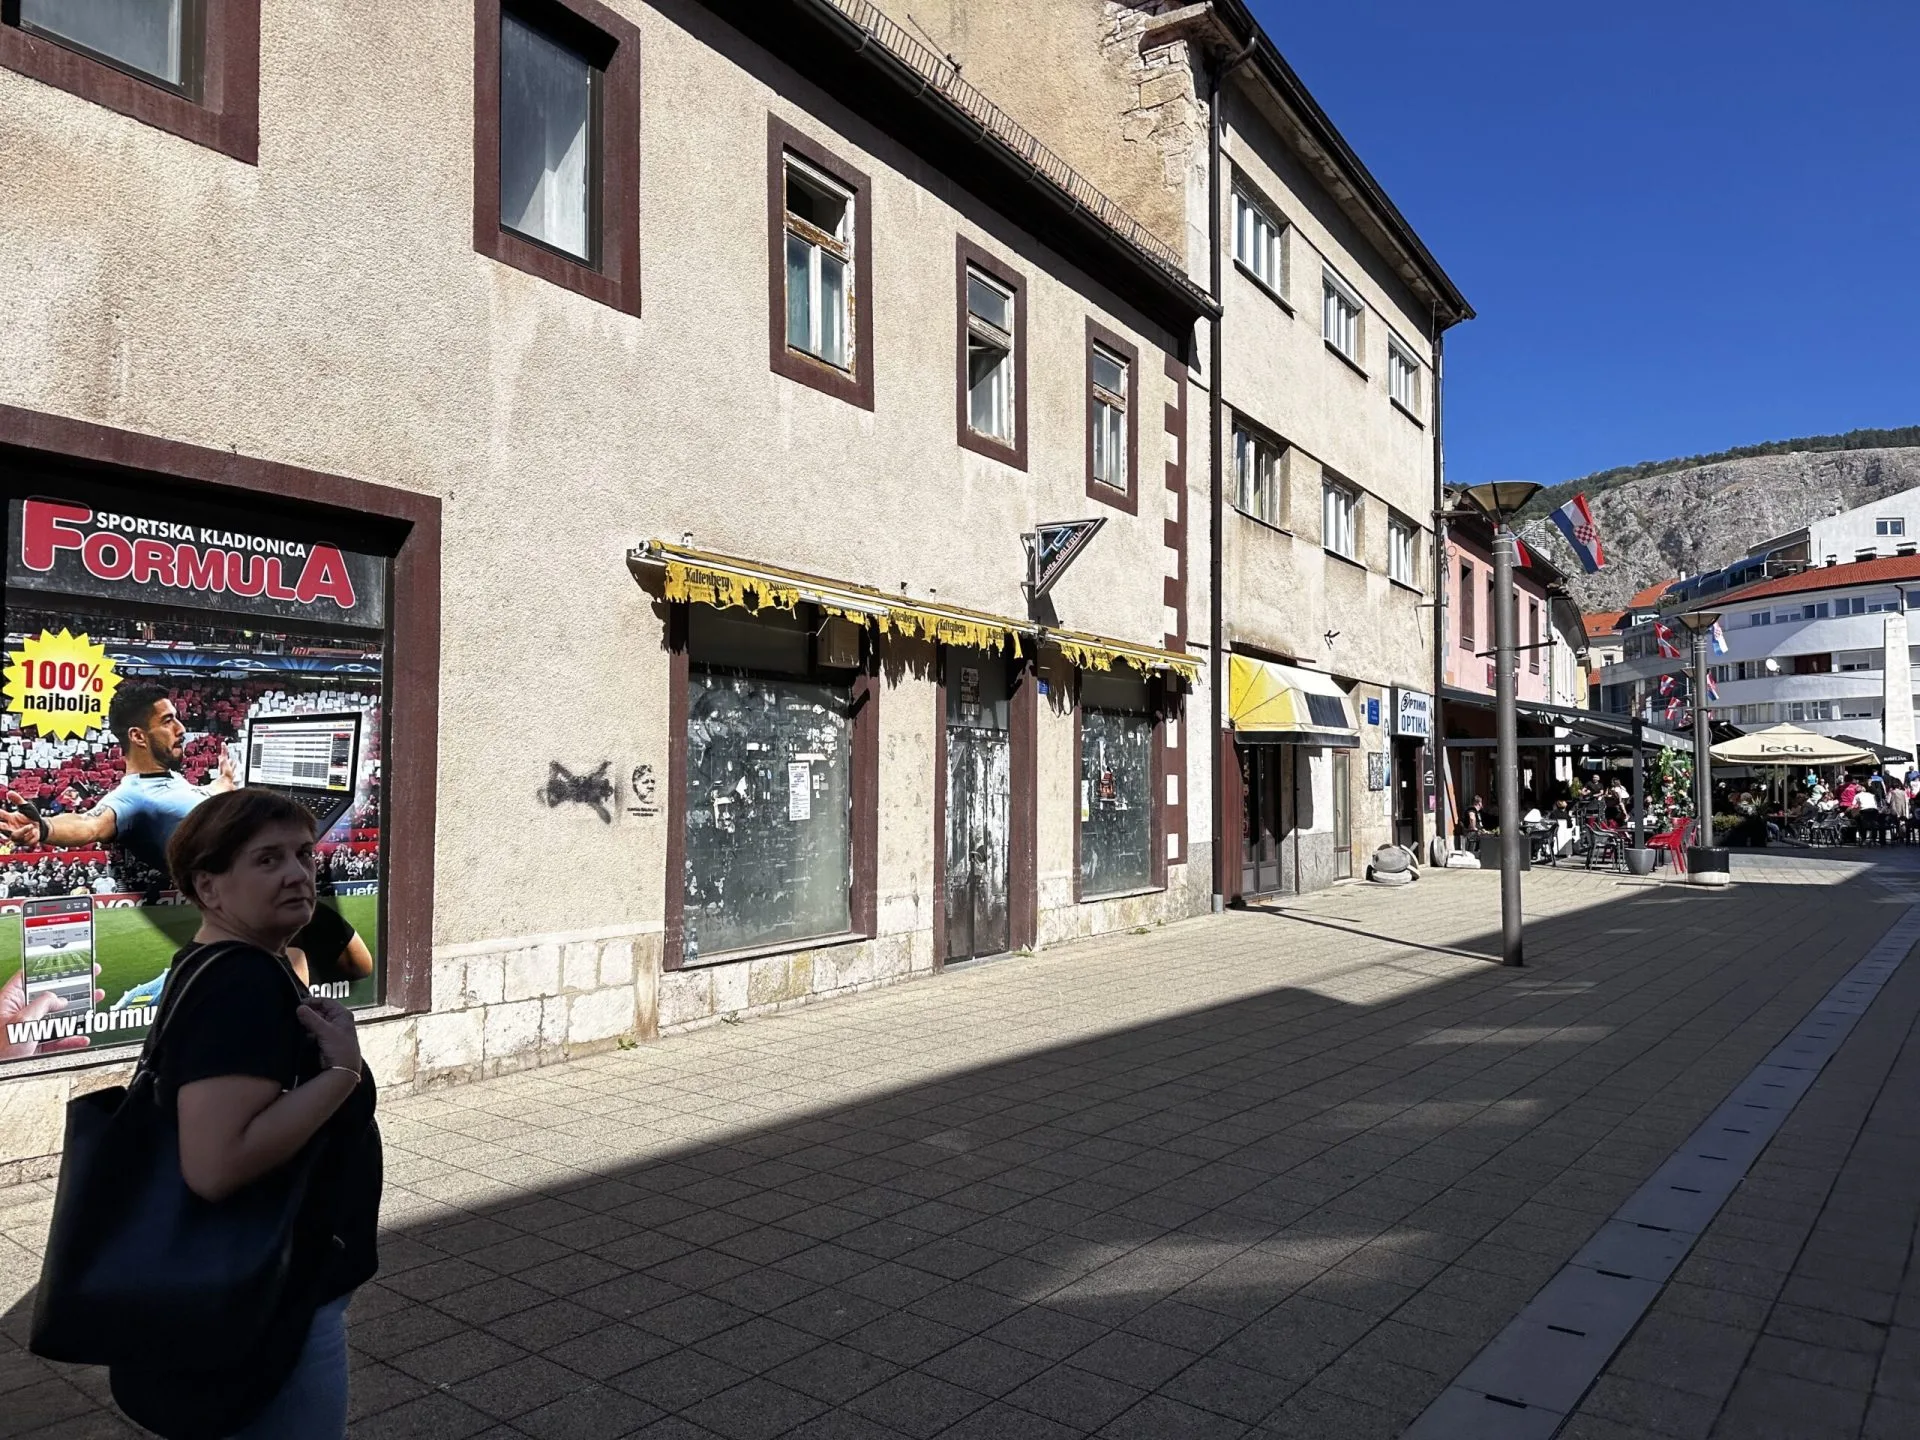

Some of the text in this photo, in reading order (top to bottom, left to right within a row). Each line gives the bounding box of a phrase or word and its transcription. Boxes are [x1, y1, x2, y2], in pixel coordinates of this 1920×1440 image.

[97, 512, 306, 559] SPORTSKA KLADIONICA
[21, 495, 356, 609] FORMULA
[684, 567, 731, 591] Kaltenberg
[20, 659, 104, 693] 100%
[23, 693, 101, 714] najbolja
[1401, 692, 1427, 712] OPTIKA
[1401, 715, 1427, 733] OPTIKA
